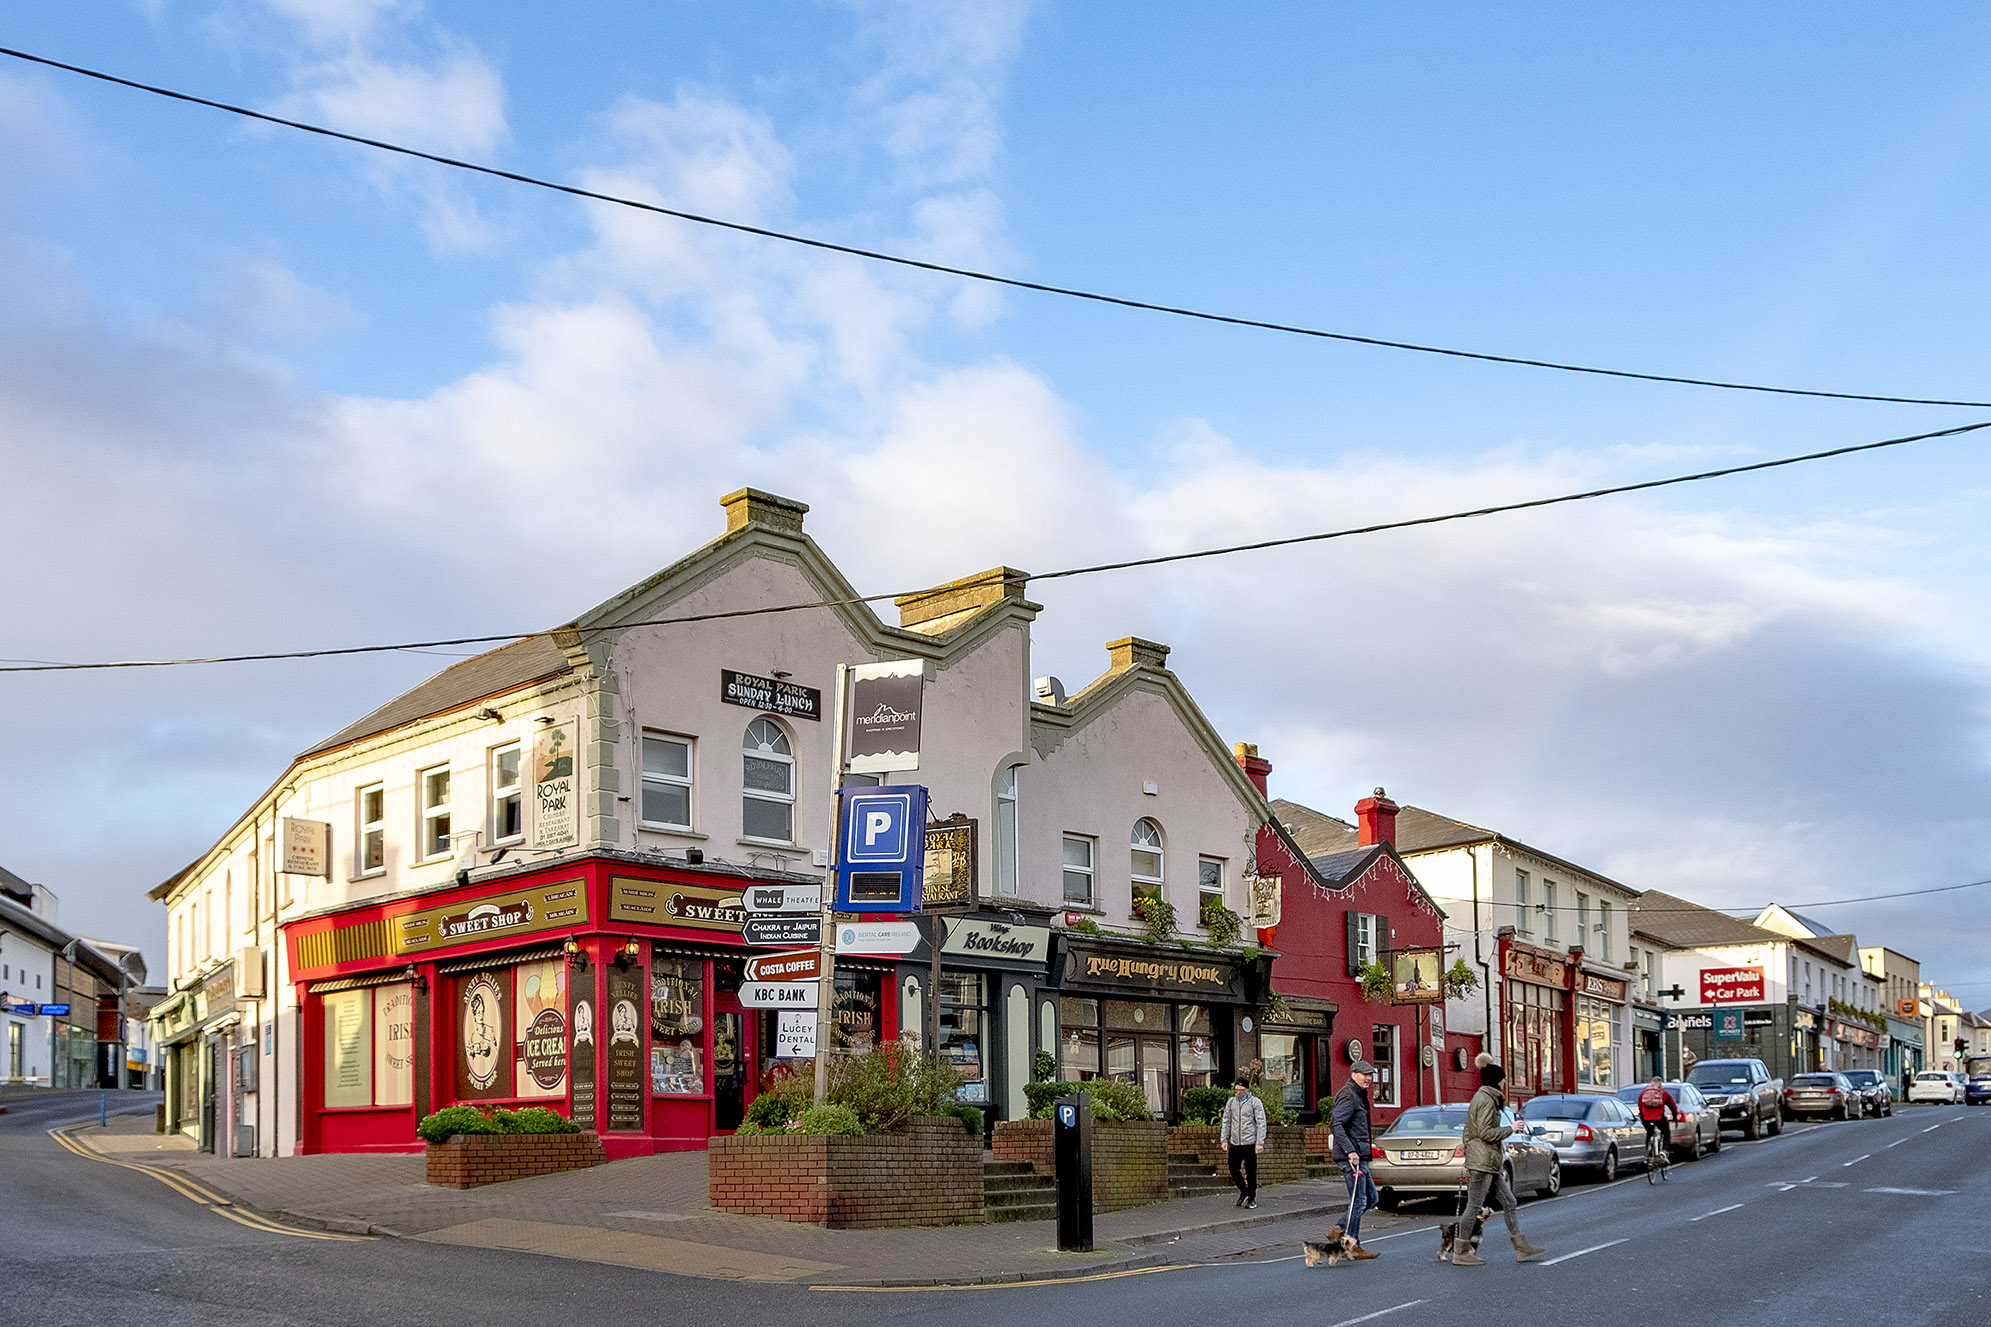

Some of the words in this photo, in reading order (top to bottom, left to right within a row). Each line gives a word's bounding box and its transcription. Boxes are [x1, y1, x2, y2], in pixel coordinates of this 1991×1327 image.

[735, 674, 773, 690] ROYAL
[774, 683, 808, 697] PARK
[728, 683, 772, 702] SUNDAY
[775, 693, 813, 712] LUNCH
[739, 698, 757, 707] OPEN
[856, 709, 916, 725] meridianpoint
[537, 780, 571, 799] ROYAL
[542, 796, 566, 813] PARK
[865, 811, 892, 846] P
[786, 895, 819, 904] THEATRE
[686, 904, 747, 922] SWEET
[449, 918, 488, 936] SWEET
[491, 911, 522, 927] SHOP
[963, 931, 1035, 957] Bookshop
[760, 963, 785, 976] COSTA
[786, 959, 815, 973] COFFEE
[1116, 958, 1178, 980] Hungry
[1178, 965, 1224, 985] Monk
[1703, 970, 1760, 986] SuperValu
[755, 989, 775, 1001] KBC
[779, 988, 806, 1001] BANK
[1716, 988, 1735, 999] Car
[1736, 986, 1760, 998] Park
[654, 999, 692, 1015] IRISH
[838, 1010, 871, 1025] IRISH
[534, 1024, 564, 1036] Delicious
[527, 1040, 540, 1057] ICE
[616, 1049, 635, 1057] IRISH
[531, 1058, 552, 1069] Served
[613, 1059, 636, 1067] SWEET
[467, 1072, 484, 1090] SWEET
[485, 1070, 498, 1089] SHOP
[616, 1069, 635, 1077] SHOP
[1063, 1107, 1074, 1123] P
